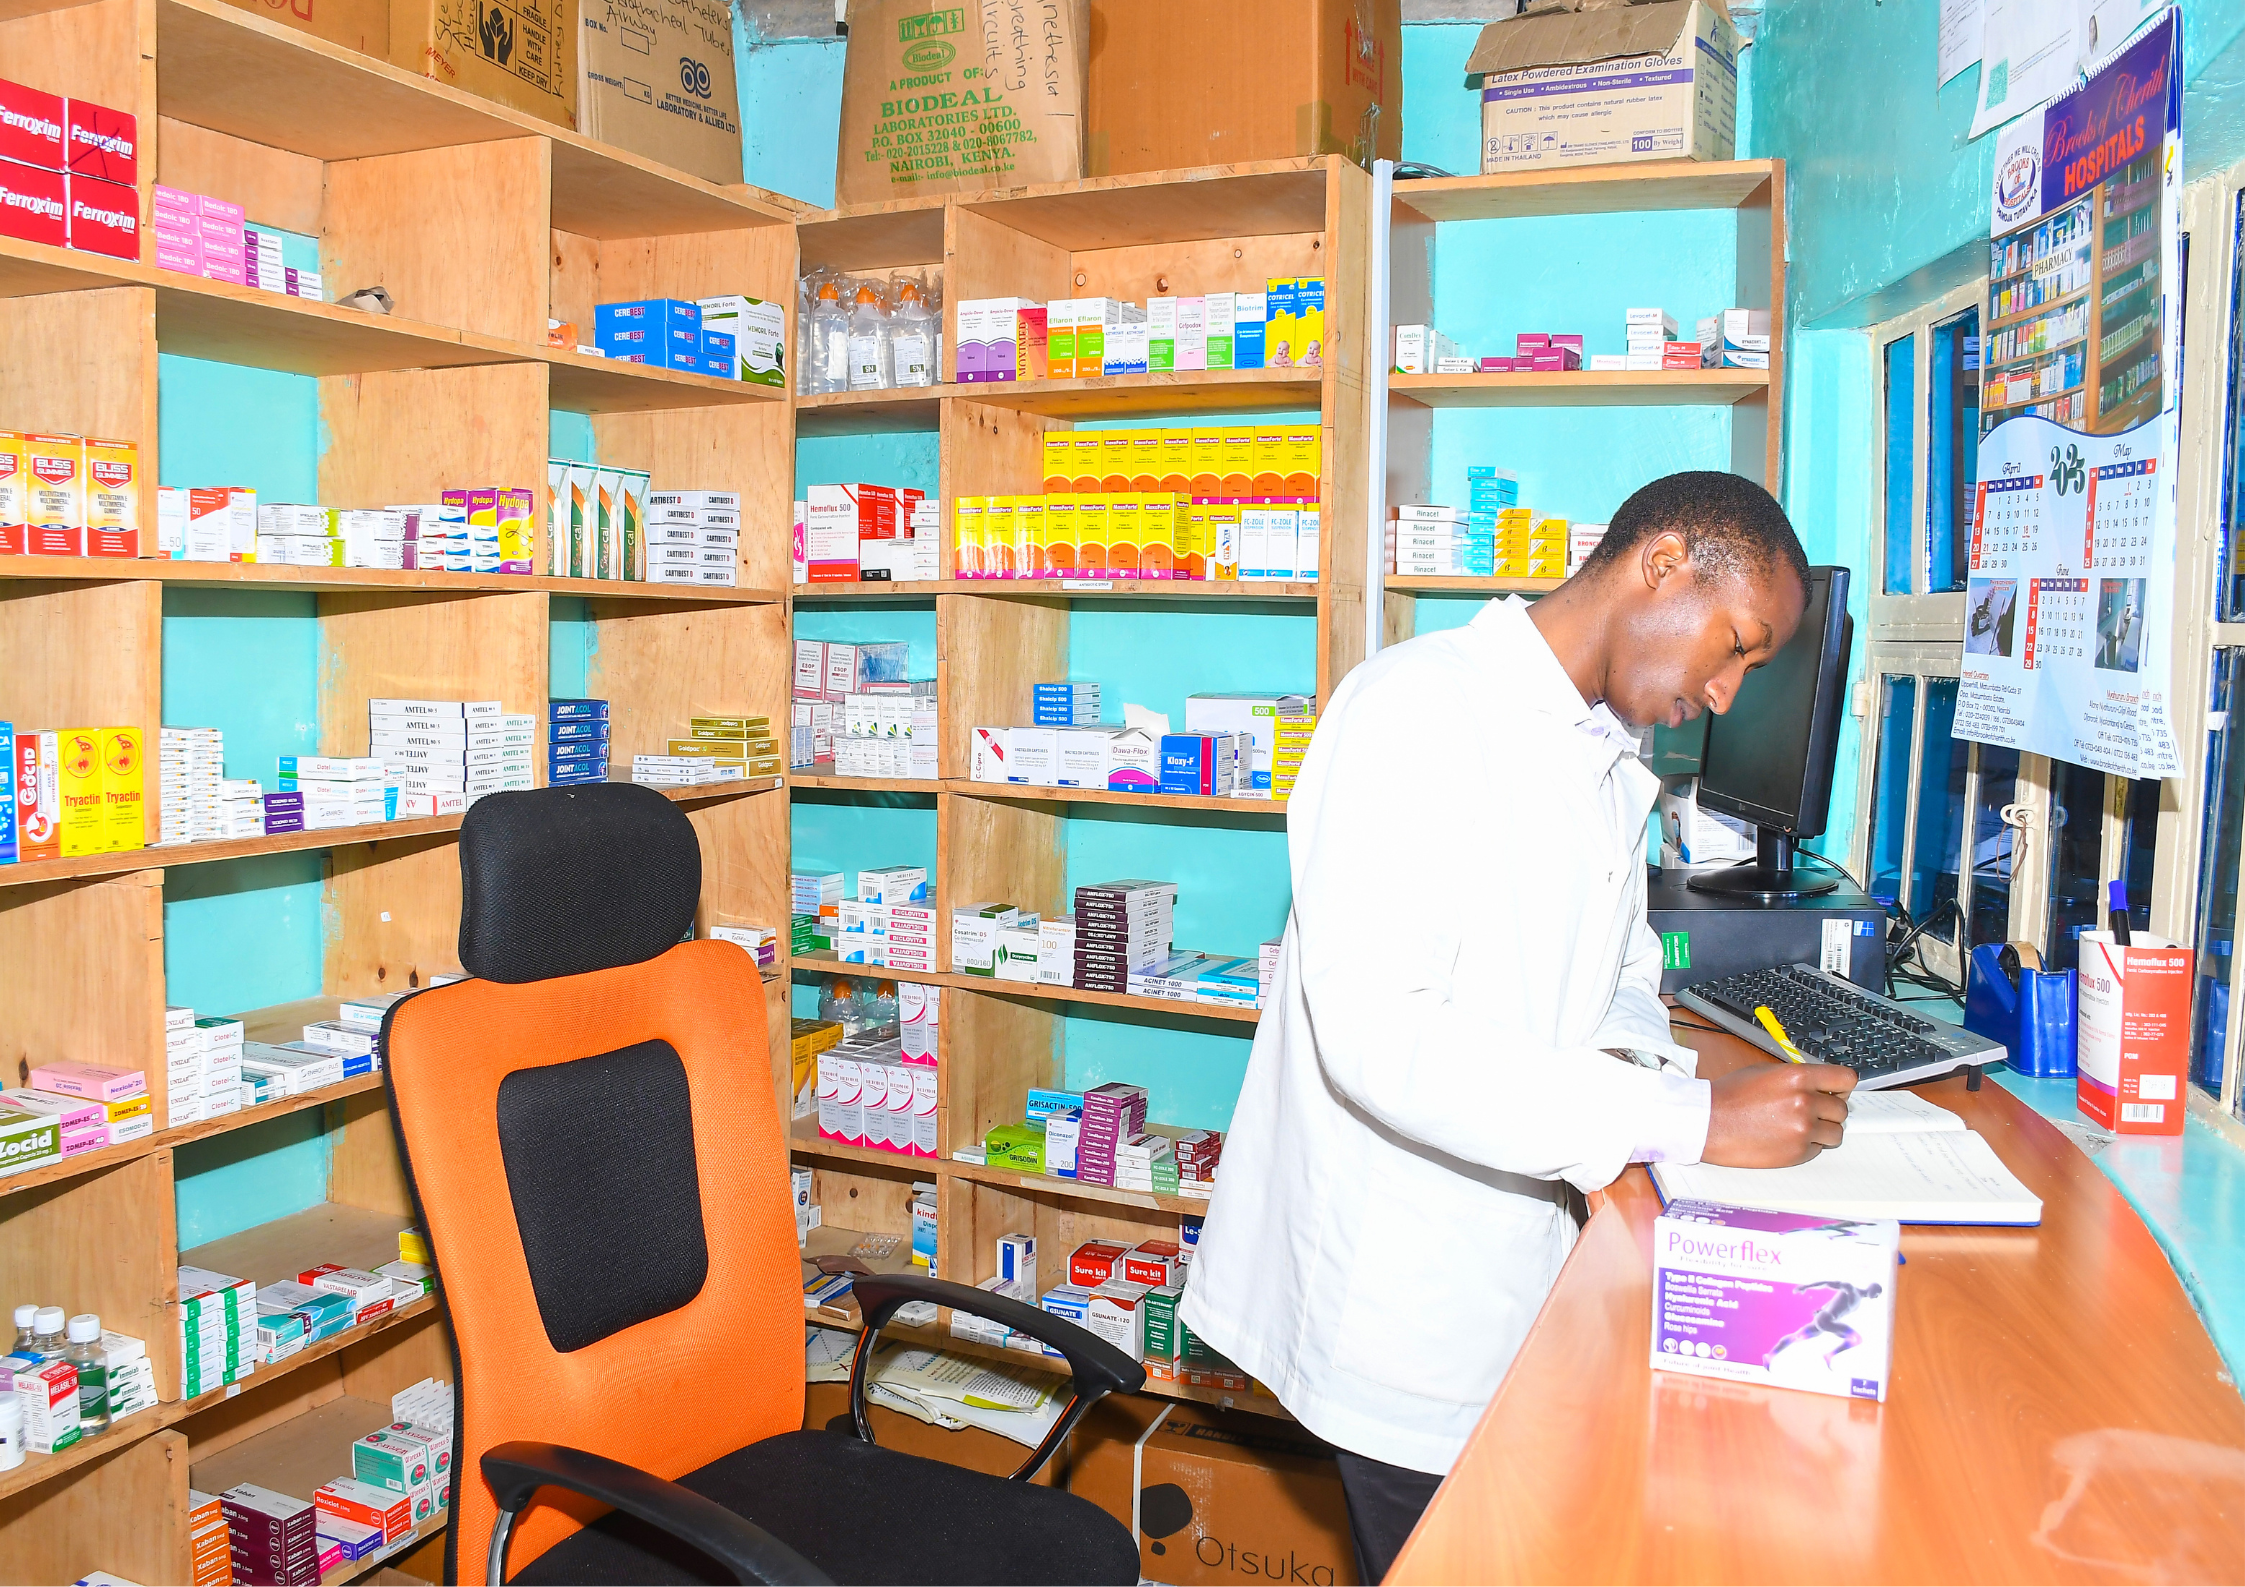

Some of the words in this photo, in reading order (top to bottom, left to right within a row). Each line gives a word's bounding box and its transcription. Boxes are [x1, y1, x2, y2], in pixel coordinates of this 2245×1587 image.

[523, 7, 547, 28] FRAGILE
[585, 18, 598, 29] BOX
[598, 24, 608, 33] No.
[606, 5, 657, 45] Airway
[522, 26, 546, 45] HANDLE
[527, 37, 542, 55] WITH
[526, 51, 543, 67] CARE
[913, 49, 945, 62] Biodeal
[425, 47, 456, 78] MEYER
[1491, 72, 1518, 85] Latex
[1521, 66, 1572, 81] Powdered
[1575, 59, 1641, 75] Examination
[1645, 55, 1682, 70] Gloves
[518, 66, 536, 80] KEEP
[536, 74, 548, 89] DRY
[587, 72, 602, 82] GROSS
[603, 76, 624, 89] WEIGHT:
[890, 81, 897, 91] A
[900, 72, 951, 89] PRODUCT
[964, 68, 983, 79] OF:
[1504, 88, 1521, 97] Single
[1546, 82, 1587, 92] Ambidextrous
[1598, 78, 1631, 87] Non-Sterile
[1645, 74, 1672, 82] Textured
[666, 92, 681, 103] BETTER
[702, 103, 717, 114] BETTER
[718, 109, 727, 118] LIFE
[881, 87, 1003, 118] BIODEAL
[1553, 103, 1575, 111] product
[0, 105, 61, 138] Ferroxim
[656, 99, 697, 122] LABORATORY
[704, 116, 725, 130] ALLIED
[726, 124, 735, 134] LTD
[874, 110, 978, 135] LABORATORIES
[983, 105, 1016, 119] LTD.
[872, 136, 892, 148] P.O.
[897, 131, 923, 145] BOX
[928, 126, 966, 141] 32040
[979, 119, 1021, 133] 00600
[71, 125, 133, 156] Ferroxim
[865, 149, 885, 162] Tel:-
[887, 141, 949, 159] 020-2015228
[953, 141, 961, 150] &
[963, 129, 1037, 149] 020-8067782,
[1633, 138, 1652, 150] 100
[890, 156, 954, 172] NAIROBI,
[962, 147, 1015, 163] KENYA.
[2064, 115, 2145, 196] HOSPITALS
[891, 173, 924, 183] e-mail:-
[927, 163, 1015, 178] info@biodeal.co.ke
[0, 187, 63, 216] Ferroxim
[74, 201, 135, 229] Ferroxim
[227, 207, 238, 215] 180
[2034, 247, 2074, 277] PHARMACY
[614, 307, 645, 317] CEREBEST
[1049, 316, 1073, 324] Eflaron
[614, 331, 645, 341] CEREBEST
[748, 325, 767, 335] MEMORIL
[768, 327, 779, 338] Forte
[1019, 322, 1028, 377] MOXIMED
[2114, 445, 2132, 459] May
[37, 459, 71, 470] BLISS
[96, 464, 128, 474] BLISS
[37, 468, 72, 477] GUMMIES
[96, 472, 129, 480] GUMMIES
[499, 494, 529, 509] Hydopa
[709, 496, 730, 504] CARTIBEST
[192, 507, 201, 515] 50
[170, 537, 181, 547] 50
[405, 706, 427, 714] AMTEL
[557, 704, 591, 714] JOINTACOL
[1255, 706, 1270, 715] 500
[558, 725, 591, 735] JOINTACOL
[1112, 745, 1148, 757] Dawa-Flox
[1167, 756, 1195, 768] Kloxy-F
[65, 794, 100, 807] Tryactin
[106, 791, 141, 804] Tryactin
[441, 799, 463, 809] AMTEL
[895, 909, 925, 918] DICLOVITA
[1041, 940, 1057, 951] 100
[966, 958, 991, 968] 800/160
[2127, 956, 2167, 967] Hemoflux
[2169, 957, 2184, 967] 500
[1144, 977, 1165, 986] ACINET
[1167, 979, 1182, 988] 1000
[1009, 1153, 1037, 1164] GRISODIN
[1060, 1160, 1073, 1169] 200
[1669, 1232, 1782, 1265] Powerflex
[1074, 1265, 1093, 1276] Sure
[1096, 1266, 1107, 1277] kit
[1129, 1266, 1149, 1276] Sure
[1150, 1267, 1161, 1278] kit
[1666, 1272, 1687, 1283] Type
[1049, 1308, 1077, 1318] GSUNATE
[1664, 1303, 1710, 1316] Curcuminoids
[1091, 1312, 1118, 1322] GSUNATE
[1664, 1323, 1681, 1331] Rose
[1682, 1325, 1697, 1335] hips
[119, 1367, 139, 1379] Immolab
[51, 1377, 78, 1396] MELASIL-10
[1852, 1385, 1876, 1395] Sachets
[316, 1495, 340, 1509] Roxiclot
[196, 1536, 216, 1549] Xaban
[1196, 1536, 1334, 1587] Otsuka
